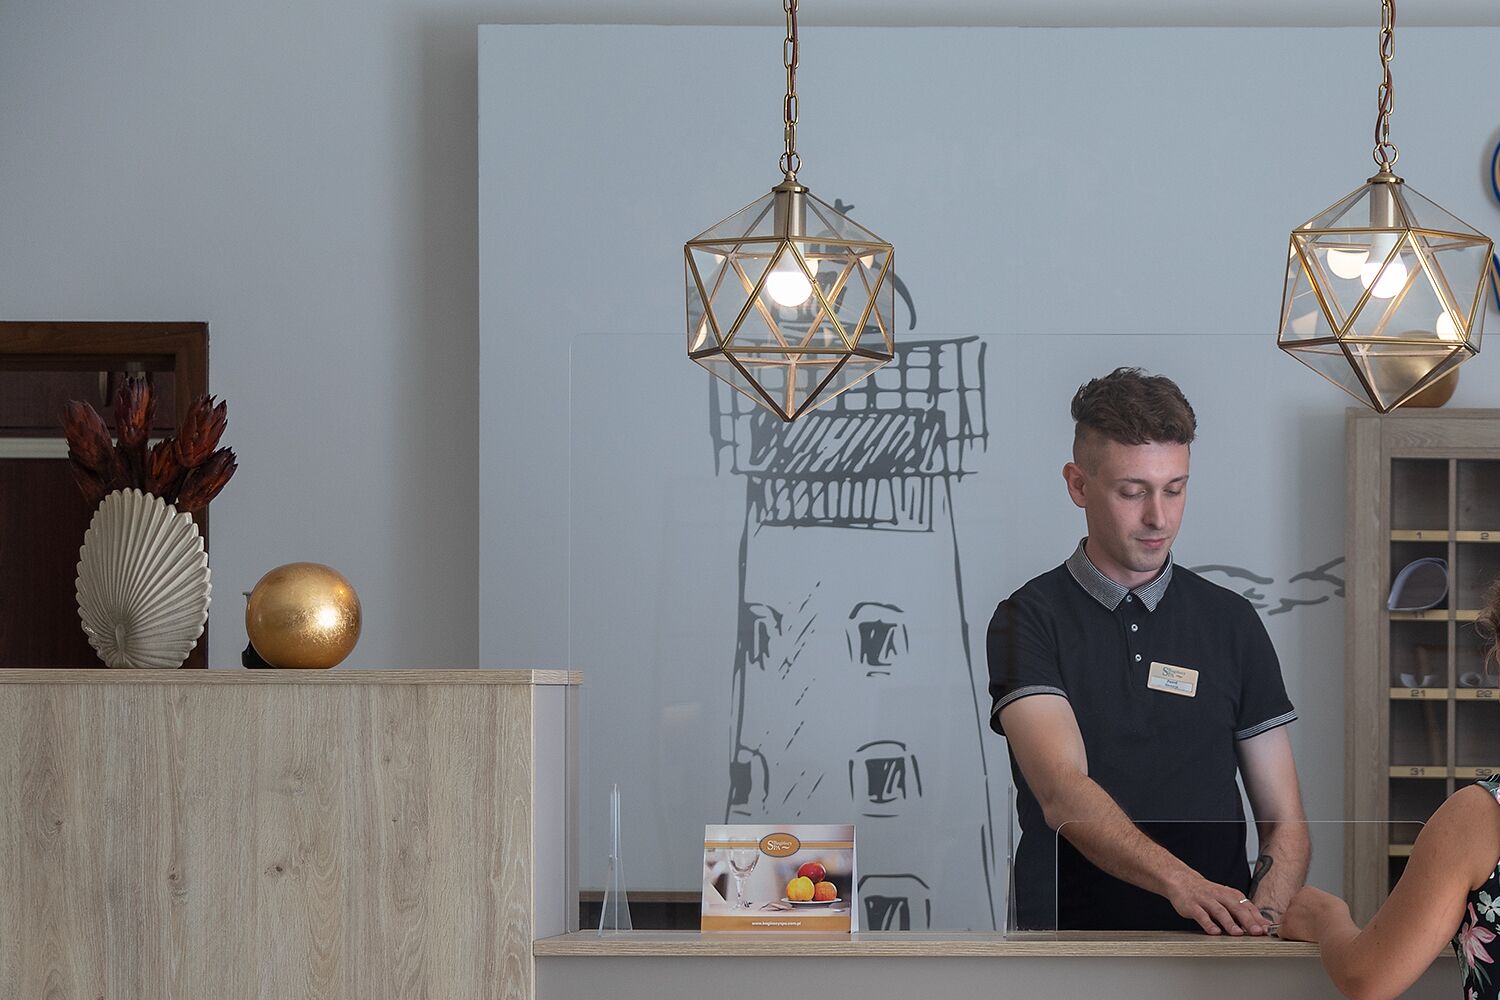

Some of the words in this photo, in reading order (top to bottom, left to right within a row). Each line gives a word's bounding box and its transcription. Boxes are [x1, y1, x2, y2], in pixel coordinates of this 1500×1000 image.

[1480, 532, 1489, 540] 2
[1410, 689, 1426, 697] 21
[1476, 690, 1492, 698] 22
[1410, 767, 1425, 775] 31
